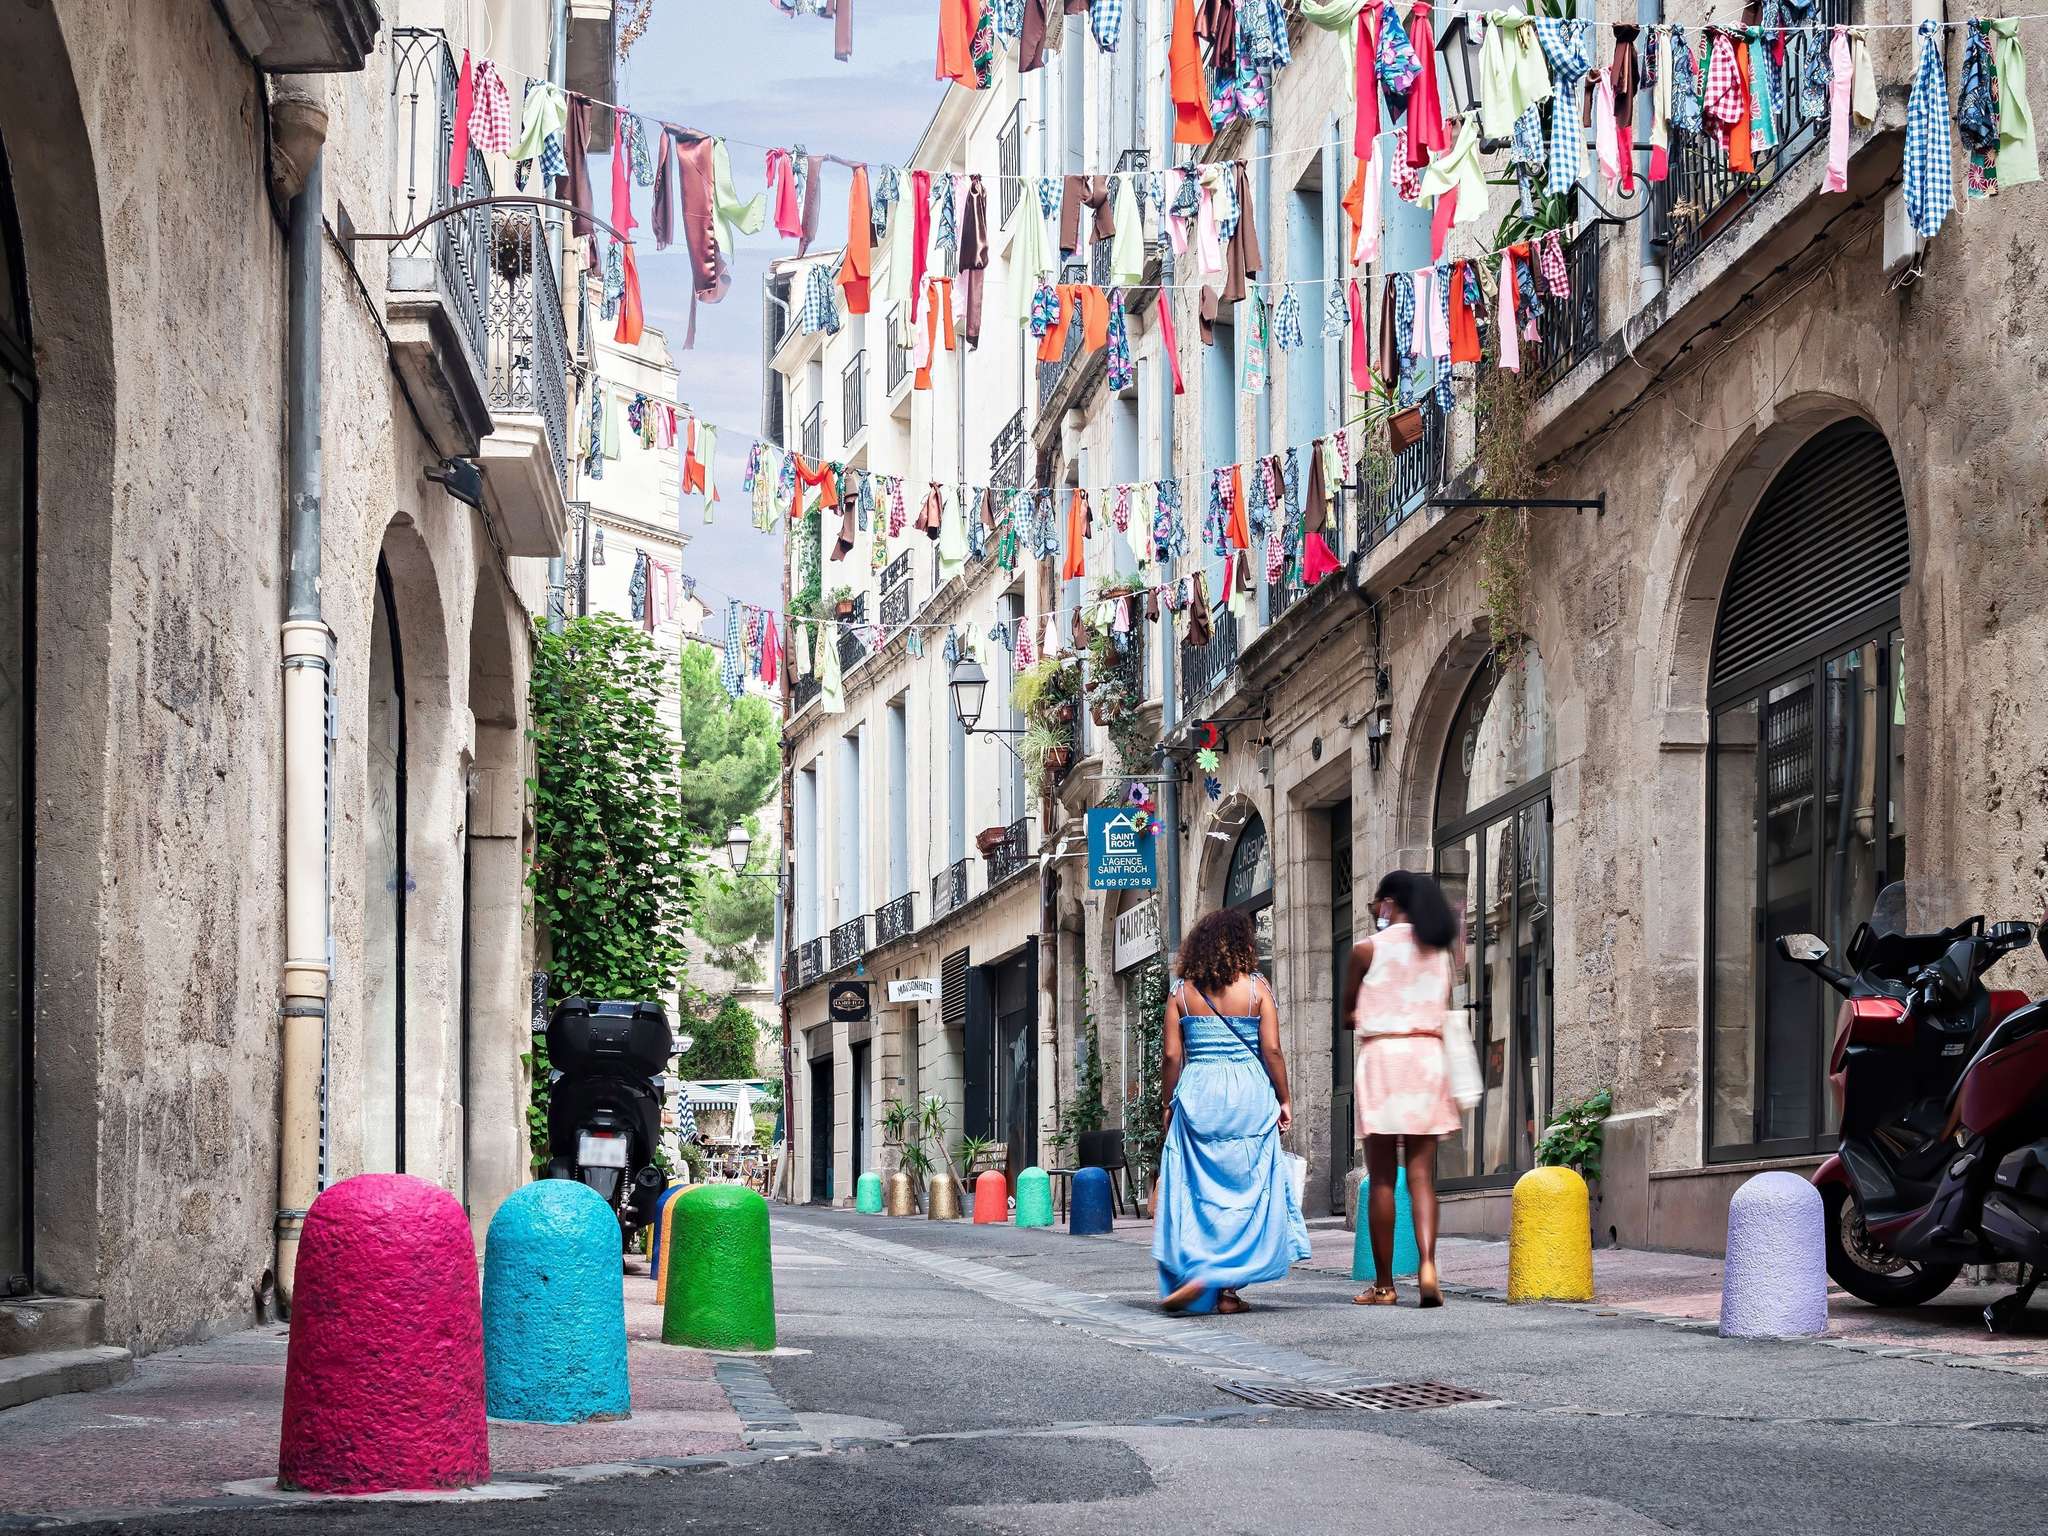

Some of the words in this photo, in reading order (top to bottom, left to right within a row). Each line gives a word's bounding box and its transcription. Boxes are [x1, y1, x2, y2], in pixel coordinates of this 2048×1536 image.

[1111, 833, 1135, 841] SAINT
[1111, 840, 1135, 848] ROCH
[1102, 857, 1143, 866] L'AGENCE
[1098, 866, 1122, 874] SAINT
[1124, 865, 1148, 873] ROCH
[1094, 879, 1105, 887] 04
[1106, 878, 1117, 887] 99
[1130, 878, 1140, 886] 29
[1142, 877, 1152, 886] 58
